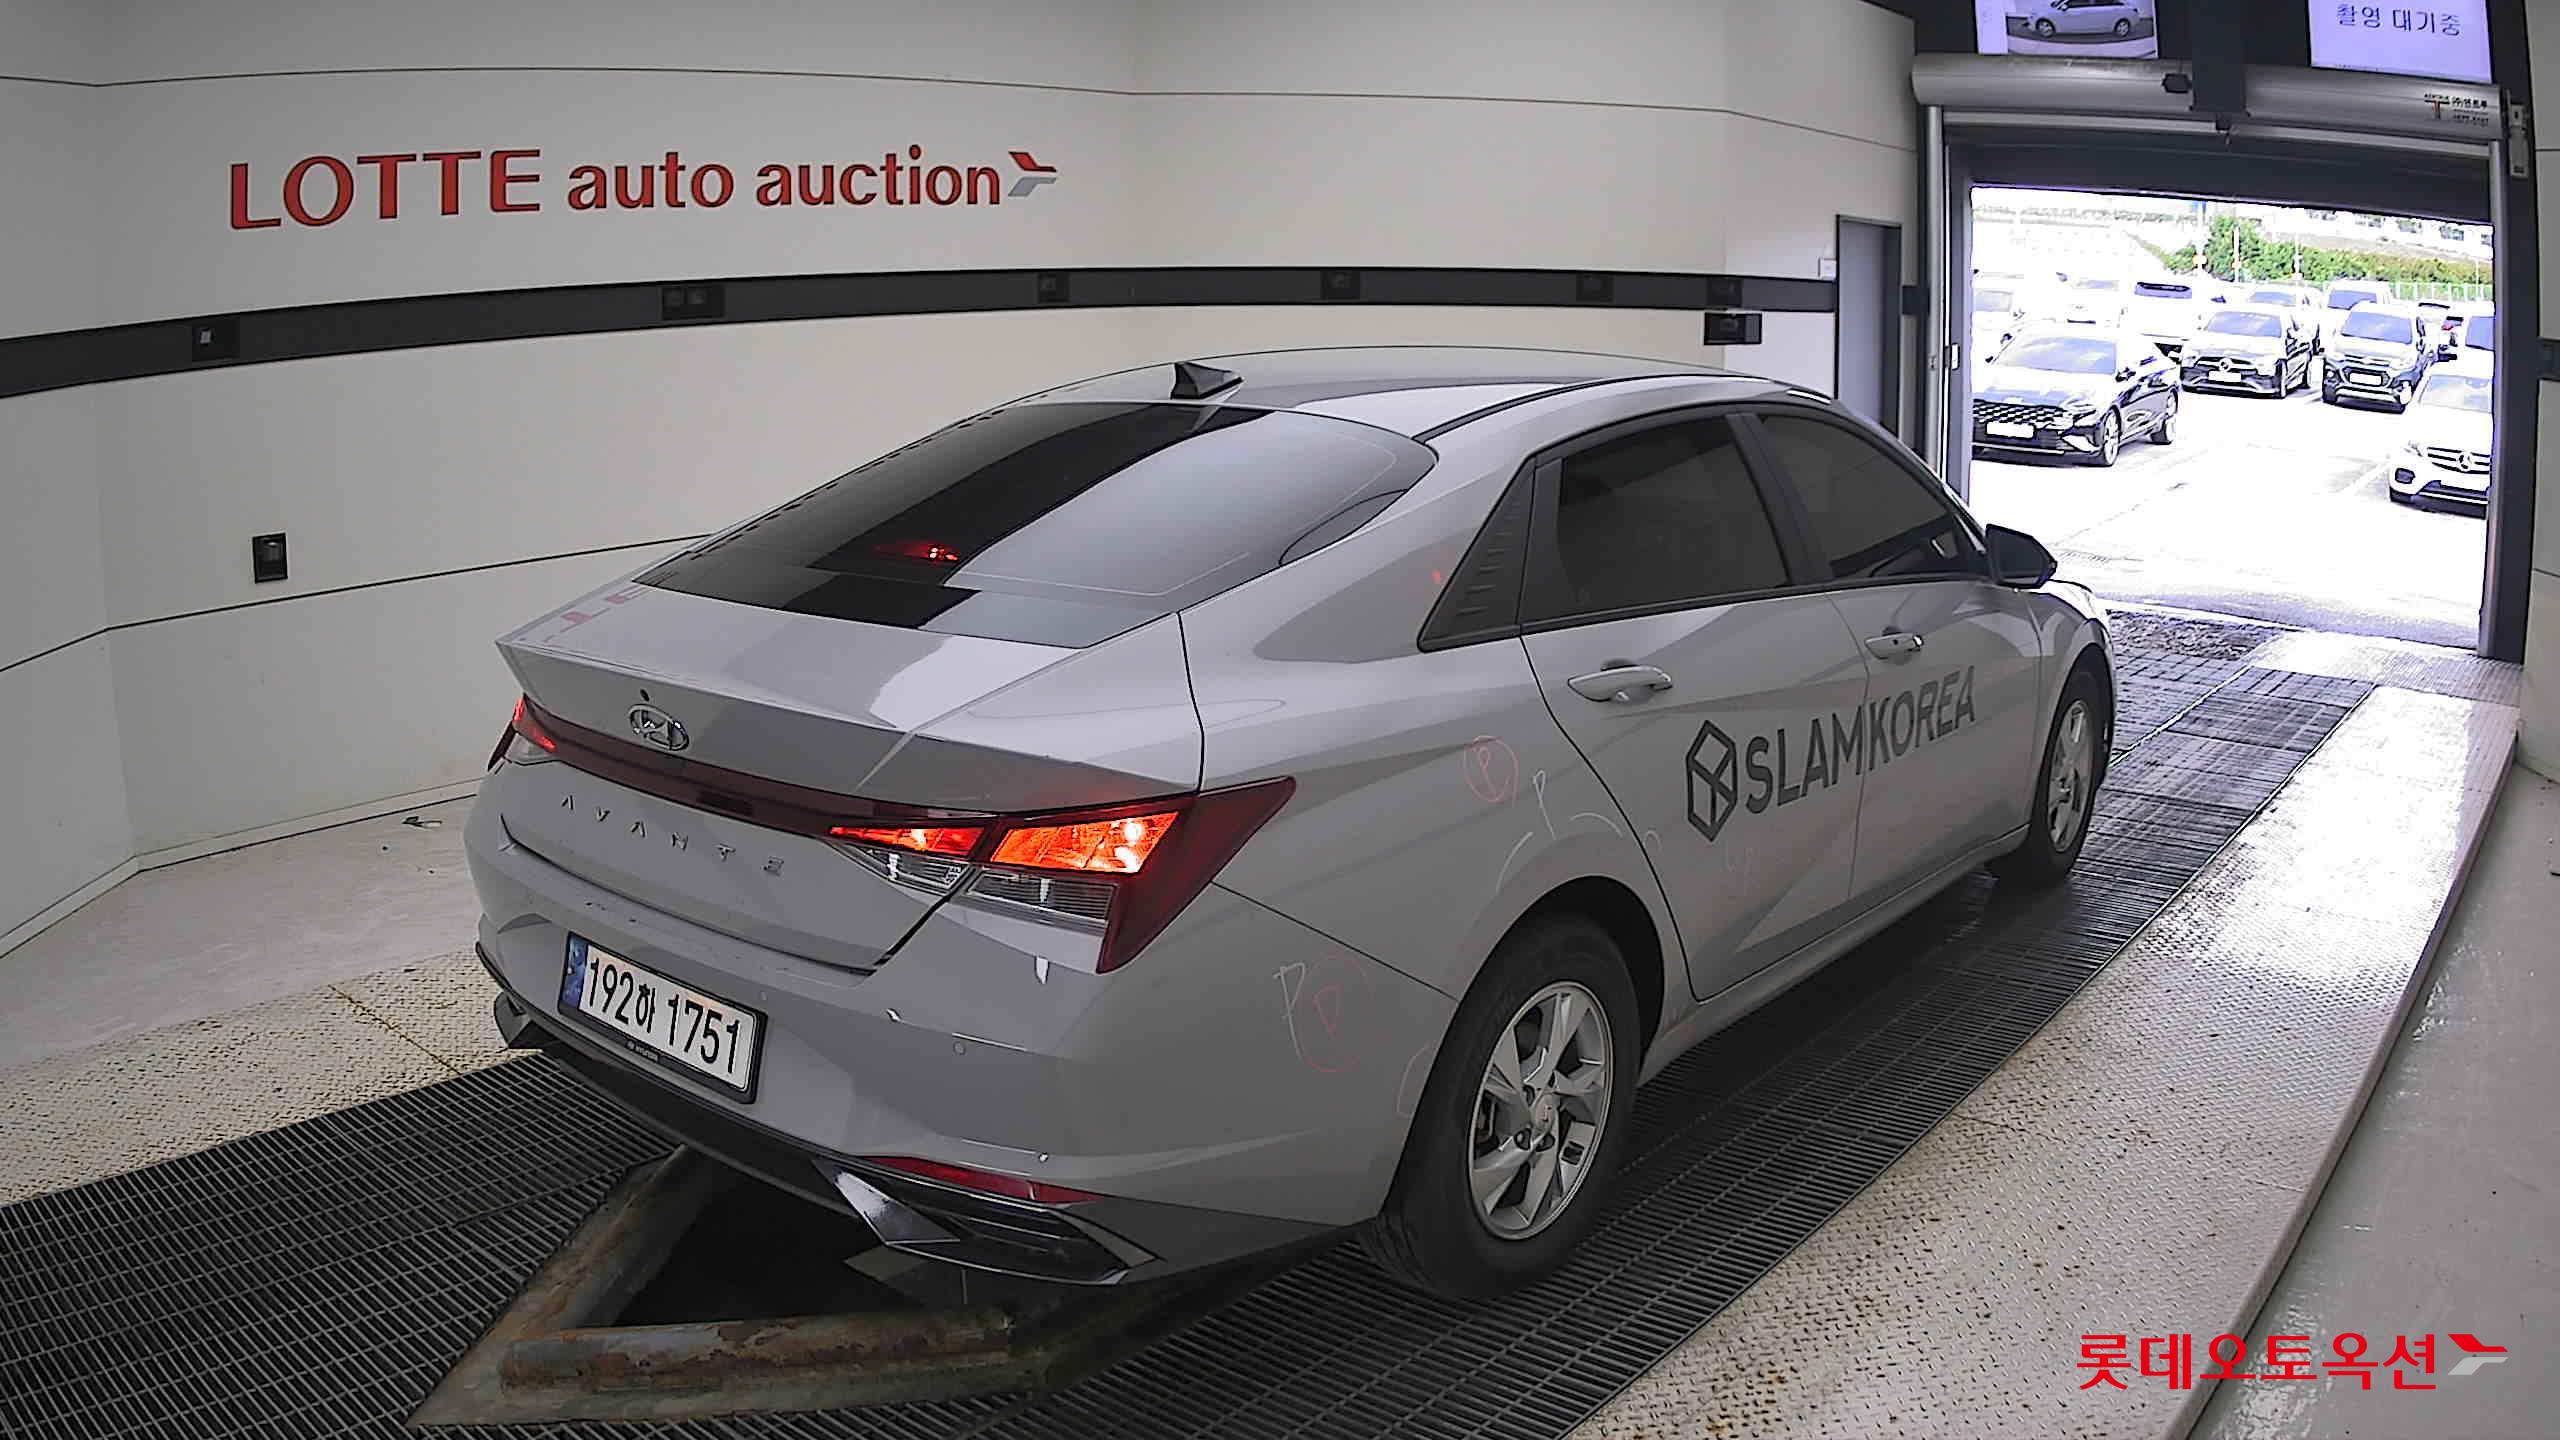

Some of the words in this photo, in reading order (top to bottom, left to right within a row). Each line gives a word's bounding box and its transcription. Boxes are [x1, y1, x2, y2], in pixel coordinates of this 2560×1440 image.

[2337, 4, 2381, 28] 촬영
[2392, 9, 2460, 37] 대기중
[230, 149, 541, 229] LOTTE
[567, 151, 735, 210] auto
[756, 144, 1001, 206] auction
[1745, 665, 1976, 814] SLAMKOREA
[561, 794, 785, 877] AVANTE
[590, 957, 656, 1034] 192하
[668, 993, 740, 1074] 1751
